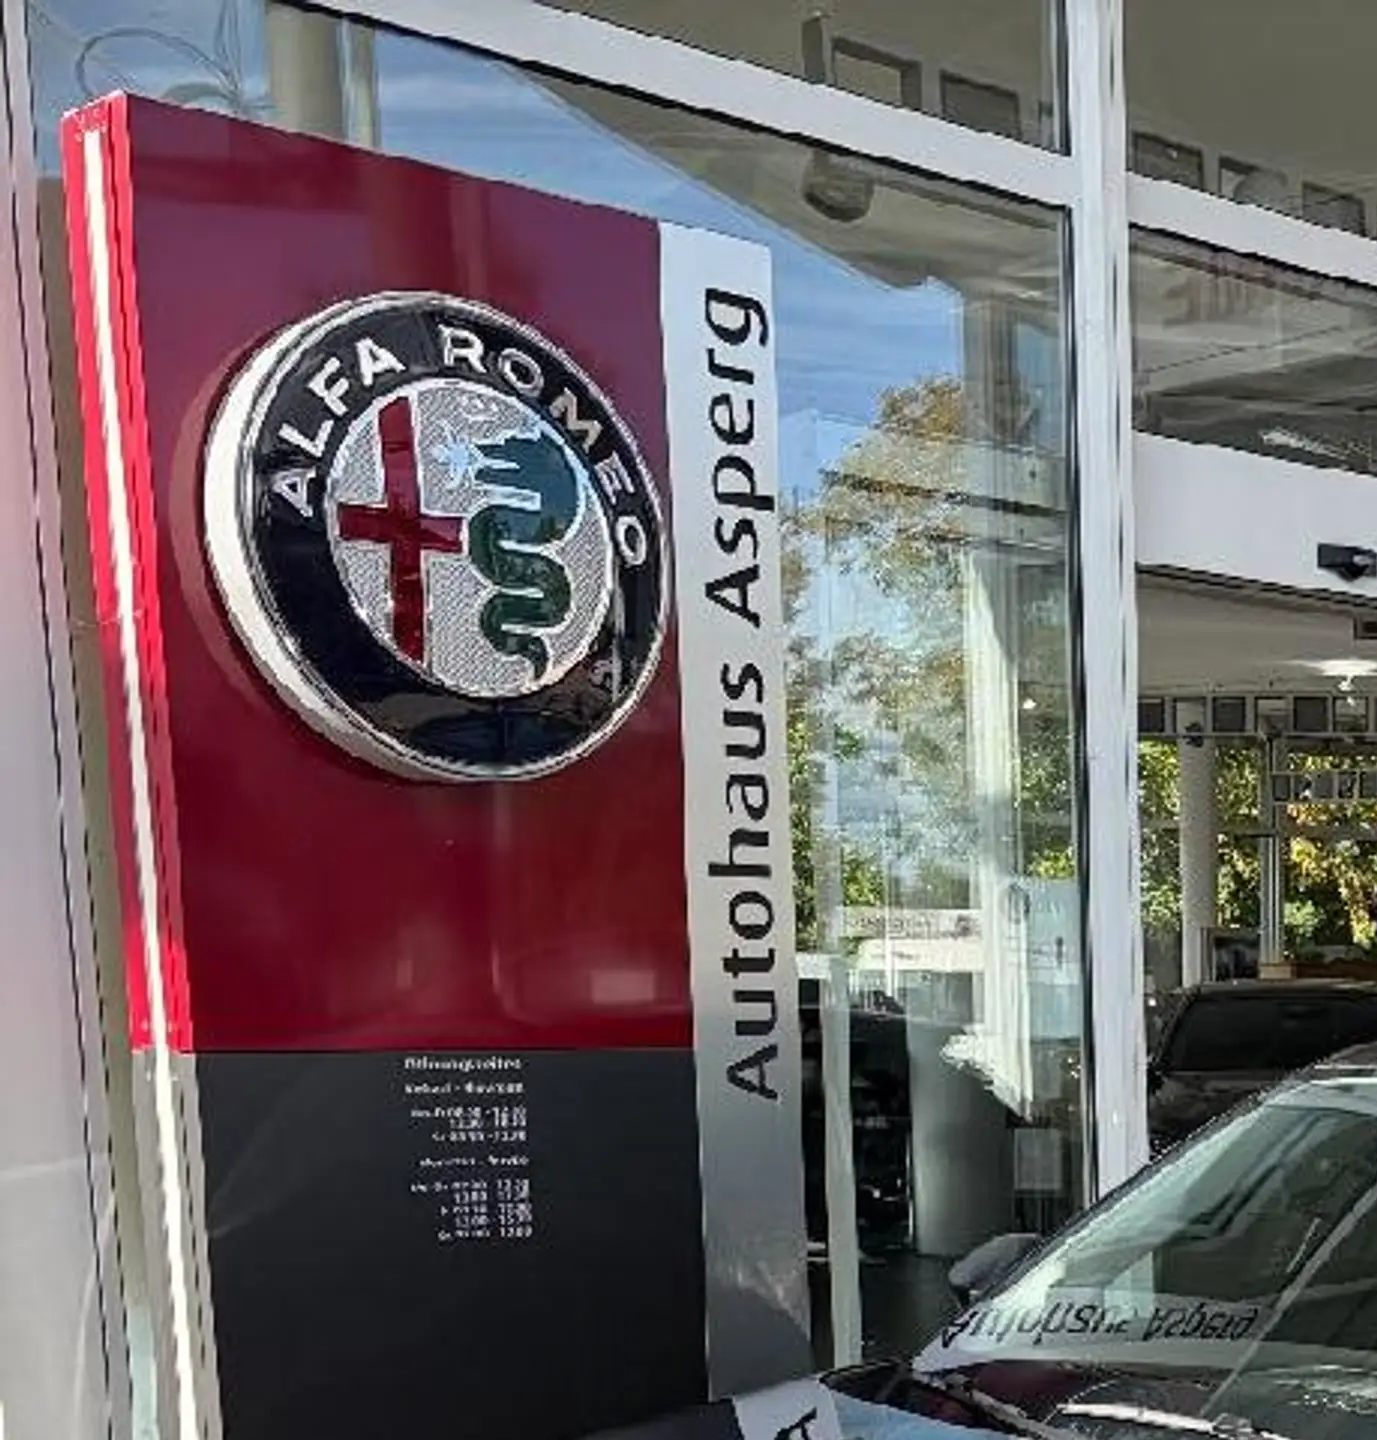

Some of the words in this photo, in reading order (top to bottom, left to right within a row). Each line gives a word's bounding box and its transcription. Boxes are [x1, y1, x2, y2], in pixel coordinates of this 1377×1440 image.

[271, 336, 406, 518] ALFA
[438, 323, 648, 568] ROMEO
[704, 288, 775, 629] Asperg
[708, 661, 779, 1101] Autohaus
